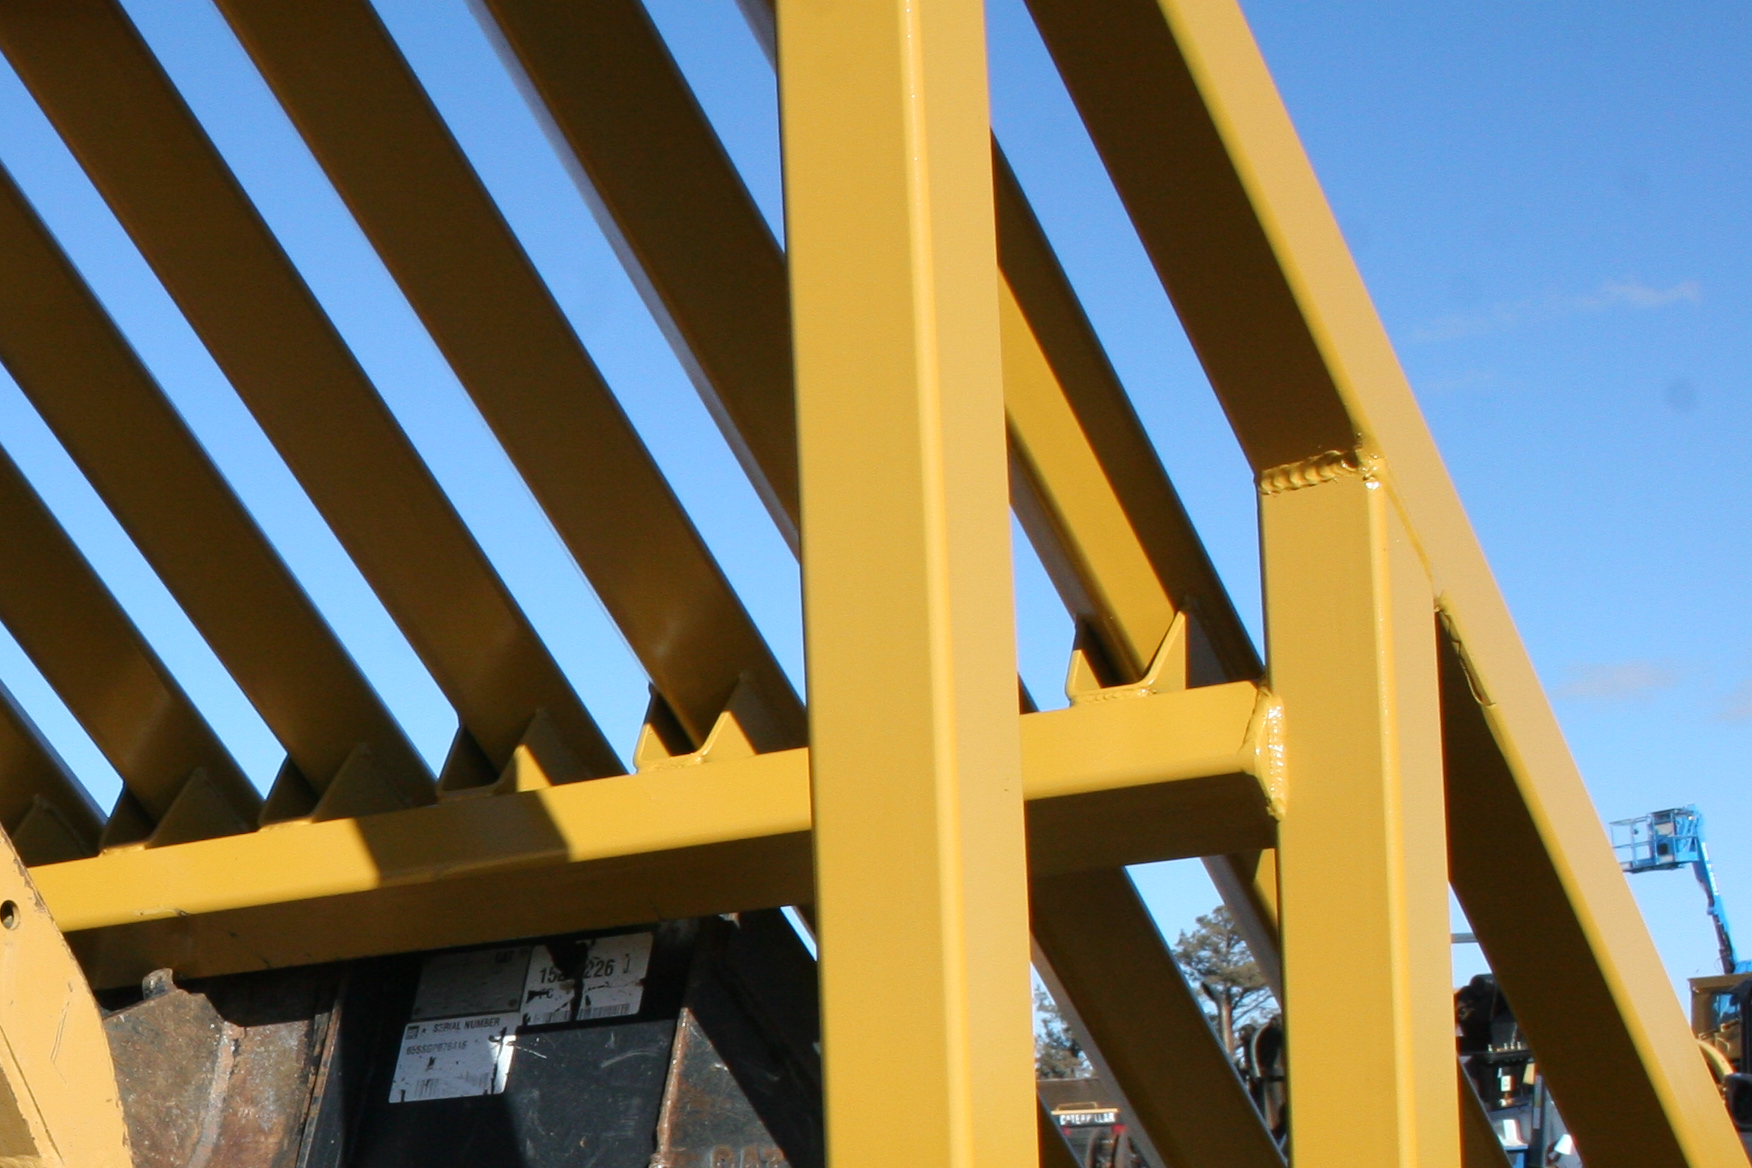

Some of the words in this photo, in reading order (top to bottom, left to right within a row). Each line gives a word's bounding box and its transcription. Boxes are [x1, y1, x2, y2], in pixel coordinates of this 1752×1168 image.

[433, 1022, 461, 1033] SERIAL
[464, 1017, 500, 1030] NUMBER
[1059, 1112, 1116, 1126] CATERPLLAR
